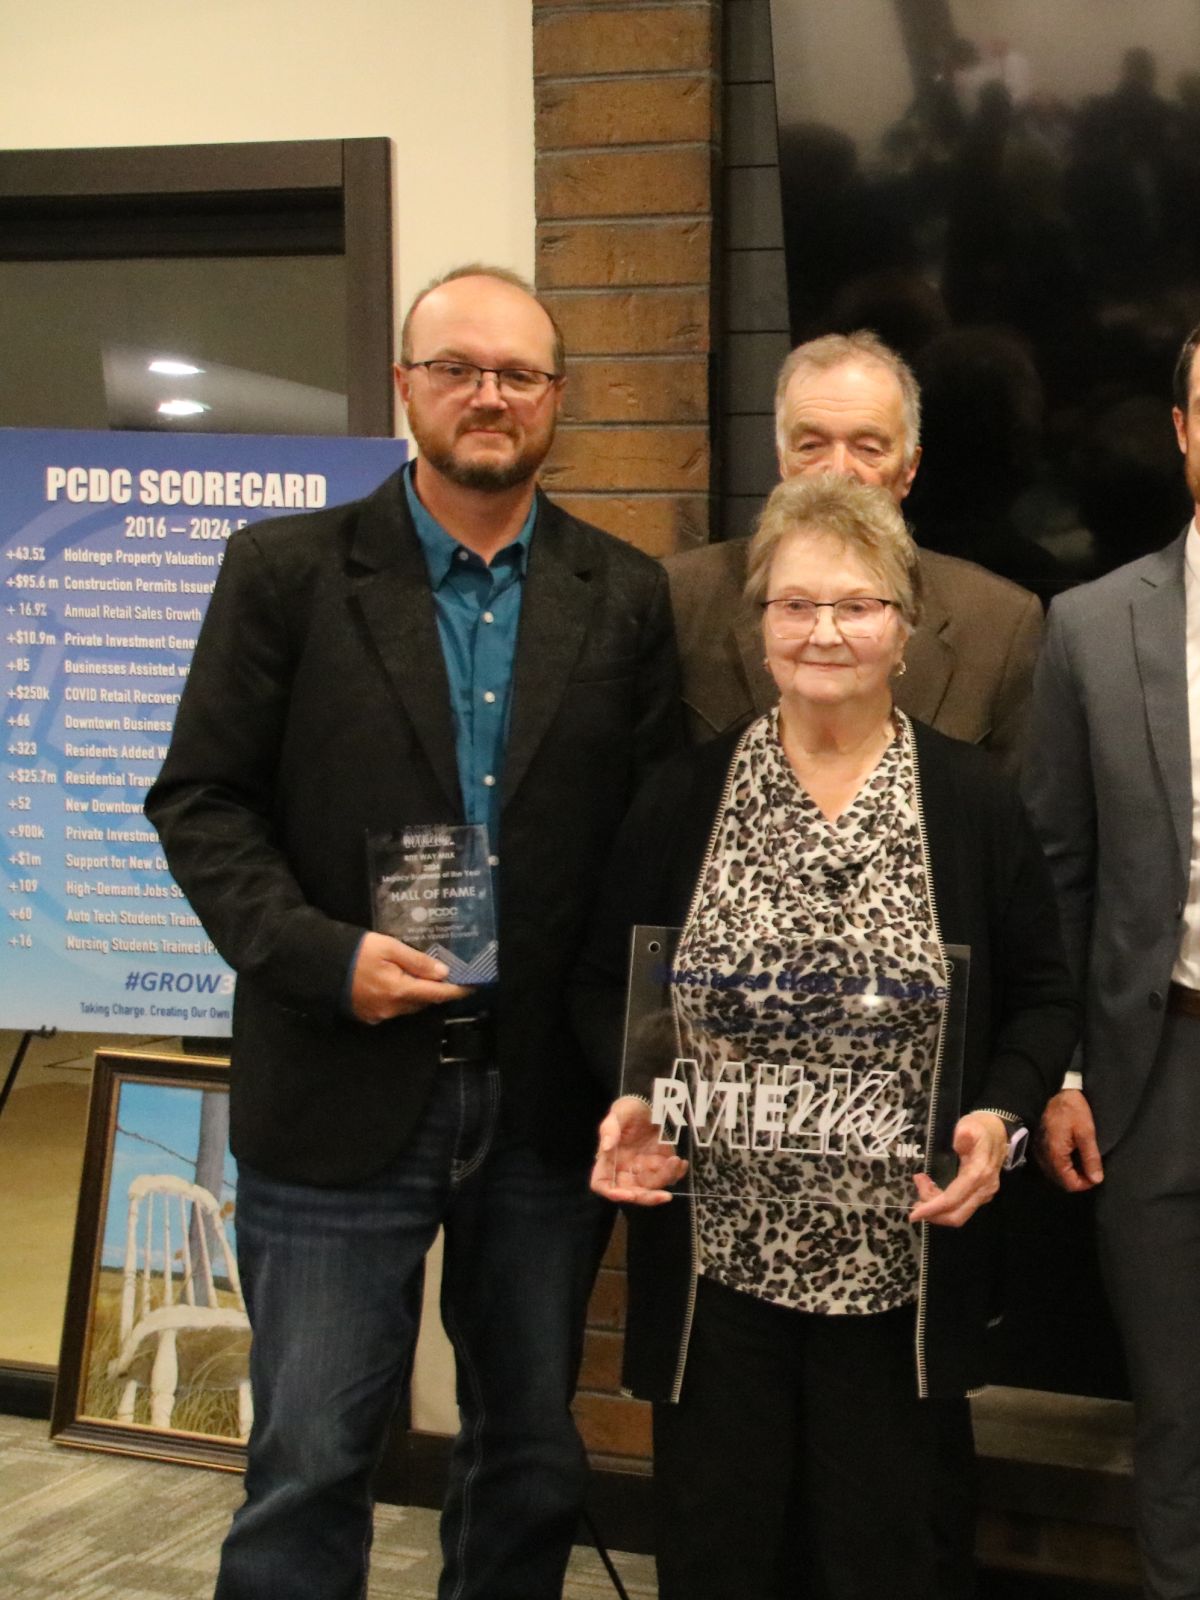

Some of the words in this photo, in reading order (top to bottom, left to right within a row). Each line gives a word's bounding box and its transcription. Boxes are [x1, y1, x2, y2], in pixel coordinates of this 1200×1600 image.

[46, 467, 132, 503] PCDC
[139, 469, 327, 509] SCORECARD
[125, 516, 167, 538] 2016
[190, 518, 231, 540] 2024
[64, 549, 113, 566] Holdrege
[116, 550, 162, 567] Property
[165, 551, 215, 566] Valuation
[64, 576, 133, 592] Construction
[136, 578, 178, 594] Permits
[64, 604, 100, 619] Annual
[103, 605, 132, 620] Retail
[135, 606, 163, 620] Sales
[166, 606, 202, 622] Growth
[64, 632, 102, 647] Private
[106, 633, 166, 649] Investment
[64, 660, 127, 675] Businesses
[129, 662, 176, 677] Assisted
[64, 687, 97, 702] COVID
[100, 688, 131, 703] Retail
[64, 715, 120, 730] Downtown
[123, 717, 172, 732] Business
[64, 744, 119, 759] Residents
[121, 745, 155, 760] Added
[65, 771, 126, 786] Residential
[65, 799, 88, 813] New
[65, 826, 104, 841] Private
[66, 853, 109, 871] Support
[111, 855, 126, 870] for
[129, 856, 152, 870] New
[66, 881, 141, 898] High-Demand
[143, 883, 168, 898] Jobs
[391, 889, 420, 902] HALL
[423, 889, 440, 900] OF
[442, 886, 476, 898] FAME
[66, 909, 90, 923] Auto
[93, 910, 118, 925] Tech
[120, 911, 168, 926] Students
[66, 936, 110, 954] Nursing
[112, 938, 159, 954] Students
[161, 939, 200, 955] Trained
[80, 1002, 110, 1017] Taking
[112, 1003, 147, 1019] Charge.
[150, 1005, 189, 1020] Creating
[192, 1006, 207, 1018] Our
[210, 1007, 230, 1020] Own
[651, 1078, 789, 1133] RITE
[896, 1144, 925, 1158] INC.
